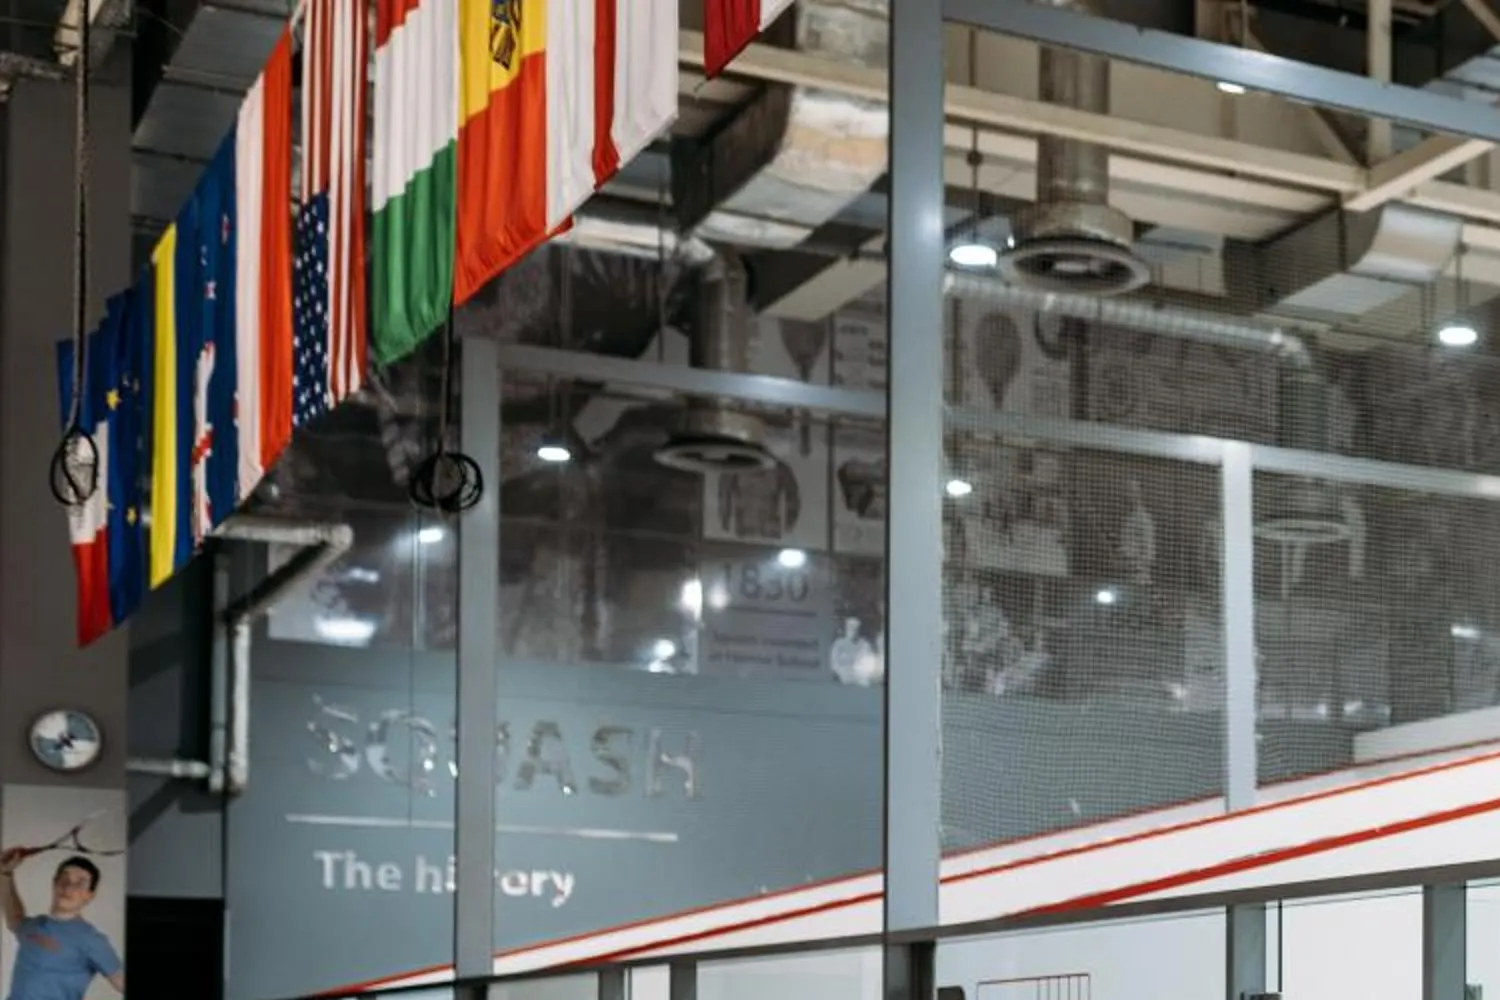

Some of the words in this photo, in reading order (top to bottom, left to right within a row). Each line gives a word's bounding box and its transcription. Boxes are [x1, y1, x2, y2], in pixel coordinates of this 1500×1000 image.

[306, 695, 699, 799] SQASH
[313, 850, 401, 890] The
[414, 855, 576, 907] hiory
